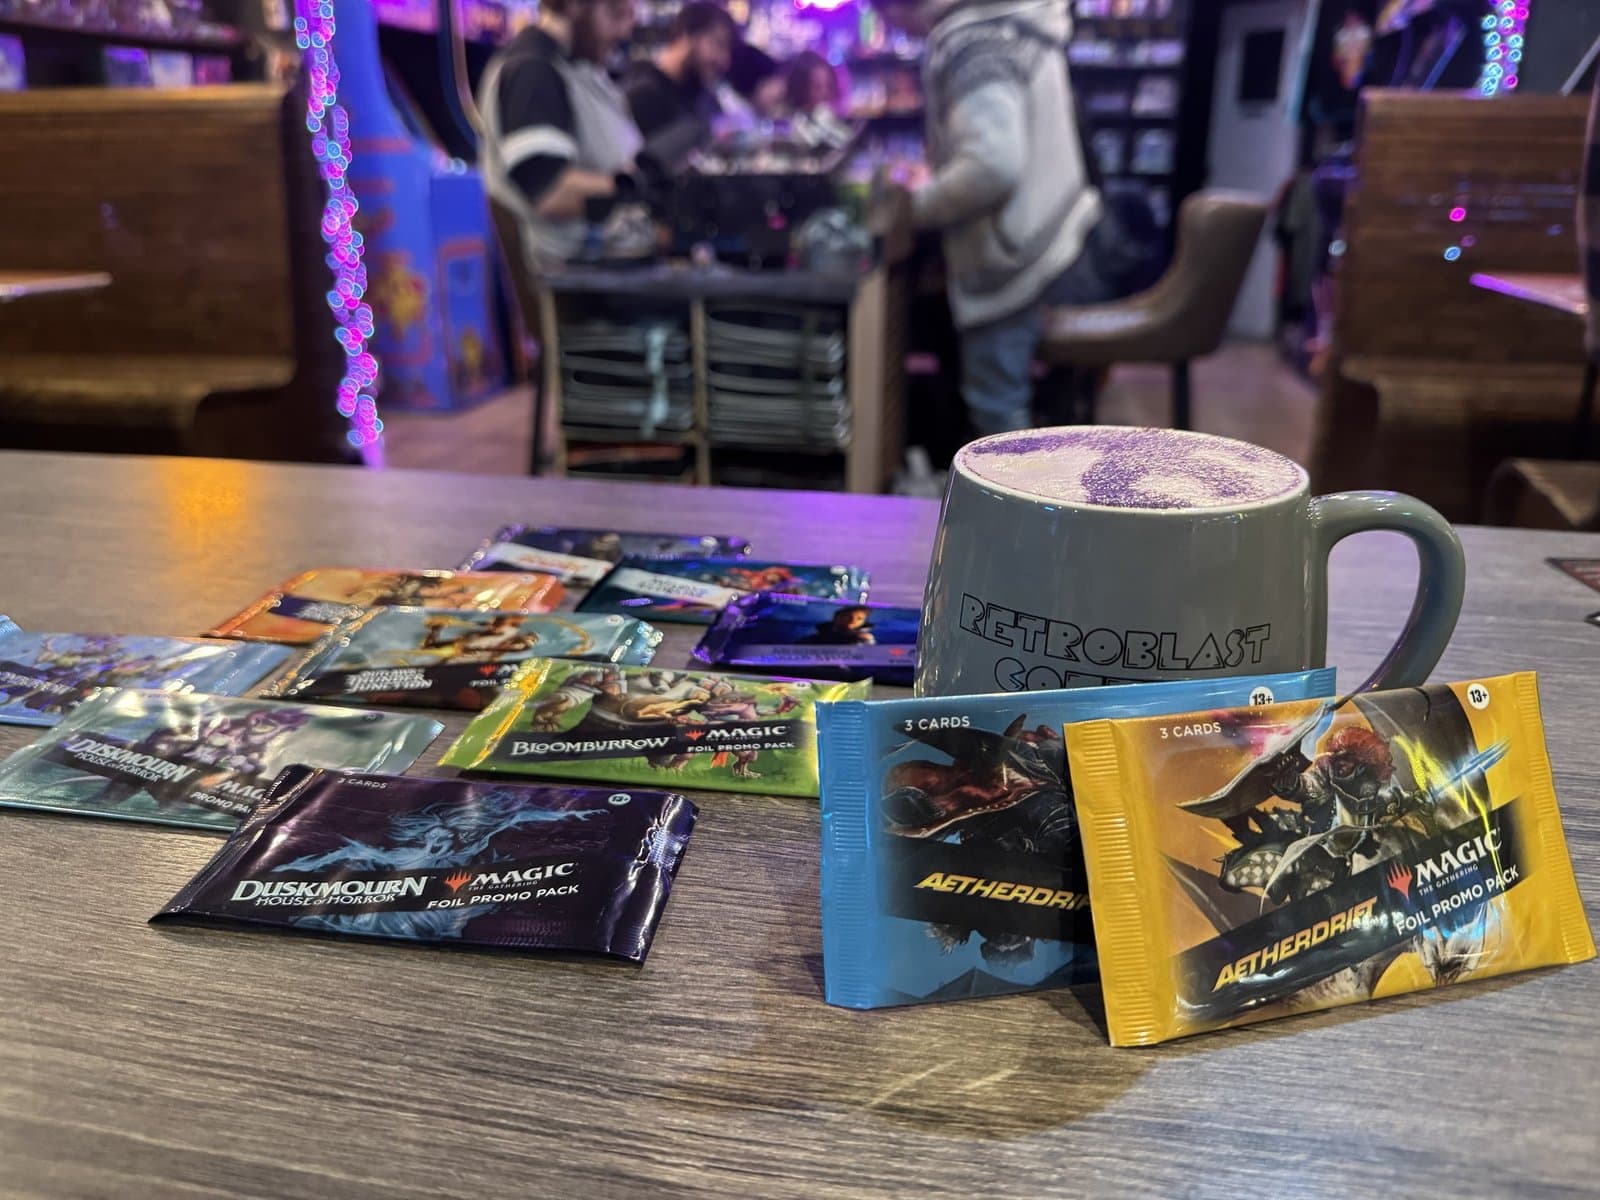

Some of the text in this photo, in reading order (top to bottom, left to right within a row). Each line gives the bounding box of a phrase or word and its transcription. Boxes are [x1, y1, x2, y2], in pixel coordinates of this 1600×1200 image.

[959, 592, 1271, 671] RETROBLAST
[1252, 693, 1273, 706] 13+
[1469, 690, 1489, 704] 13+
[706, 725, 787, 738] MAGIC
[905, 716, 971, 731] 3 CARDS
[1159, 721, 1222, 739] 3 CARDS
[510, 736, 670, 756] BLOOMBURROW
[687, 741, 795, 752] FOIL PROMO PACK
[66, 738, 197, 783] DUSKMOURN
[74, 752, 110, 767] HOUSE
[117, 763, 163, 783] HORROR
[215, 780, 267, 800] MAG
[348, 778, 388, 789] CARDS
[190, 791, 233, 809] PROMO
[233, 803, 252, 814] PA
[1413, 828, 1503, 888] MAGIC
[469, 862, 574, 887] MAGIC
[488, 880, 548, 890] GATHERING
[1418, 864, 1479, 896] THE GATHERING
[230, 876, 428, 902] DUSKMOURN
[427, 883, 579, 910] FOIL PROMO PACK
[255, 895, 312, 907] HOUSE
[325, 893, 396, 906] HORROR
[1396, 869, 1519, 936] FOIL PROMO PACK
[1211, 896, 1377, 992] AETHERDRIFT
